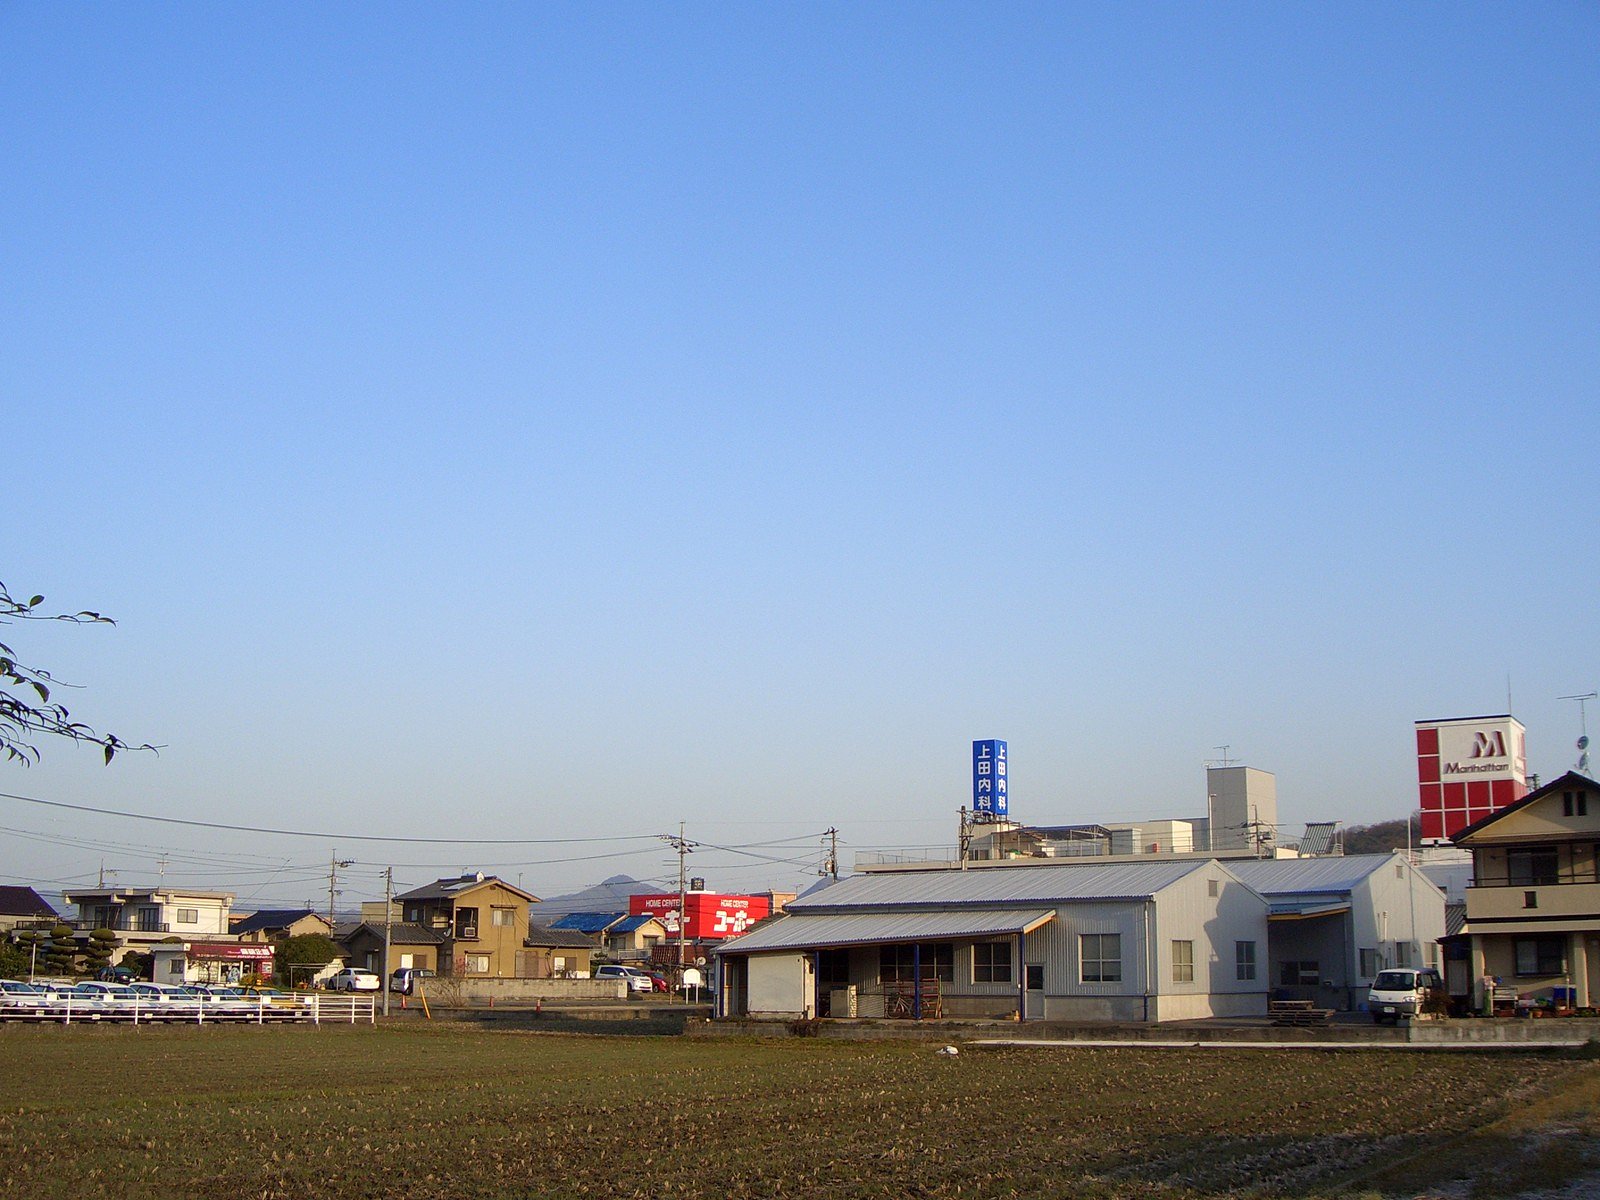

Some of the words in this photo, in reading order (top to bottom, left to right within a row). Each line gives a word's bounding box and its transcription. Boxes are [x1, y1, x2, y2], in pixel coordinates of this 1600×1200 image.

[978, 744, 991, 810] 上田内科
[998, 745, 1006, 810] 上田内科
[1444, 762, 1509, 774] Manhattan
[645, 899, 661, 908] HOME
[662, 898, 681, 907] CENTE
